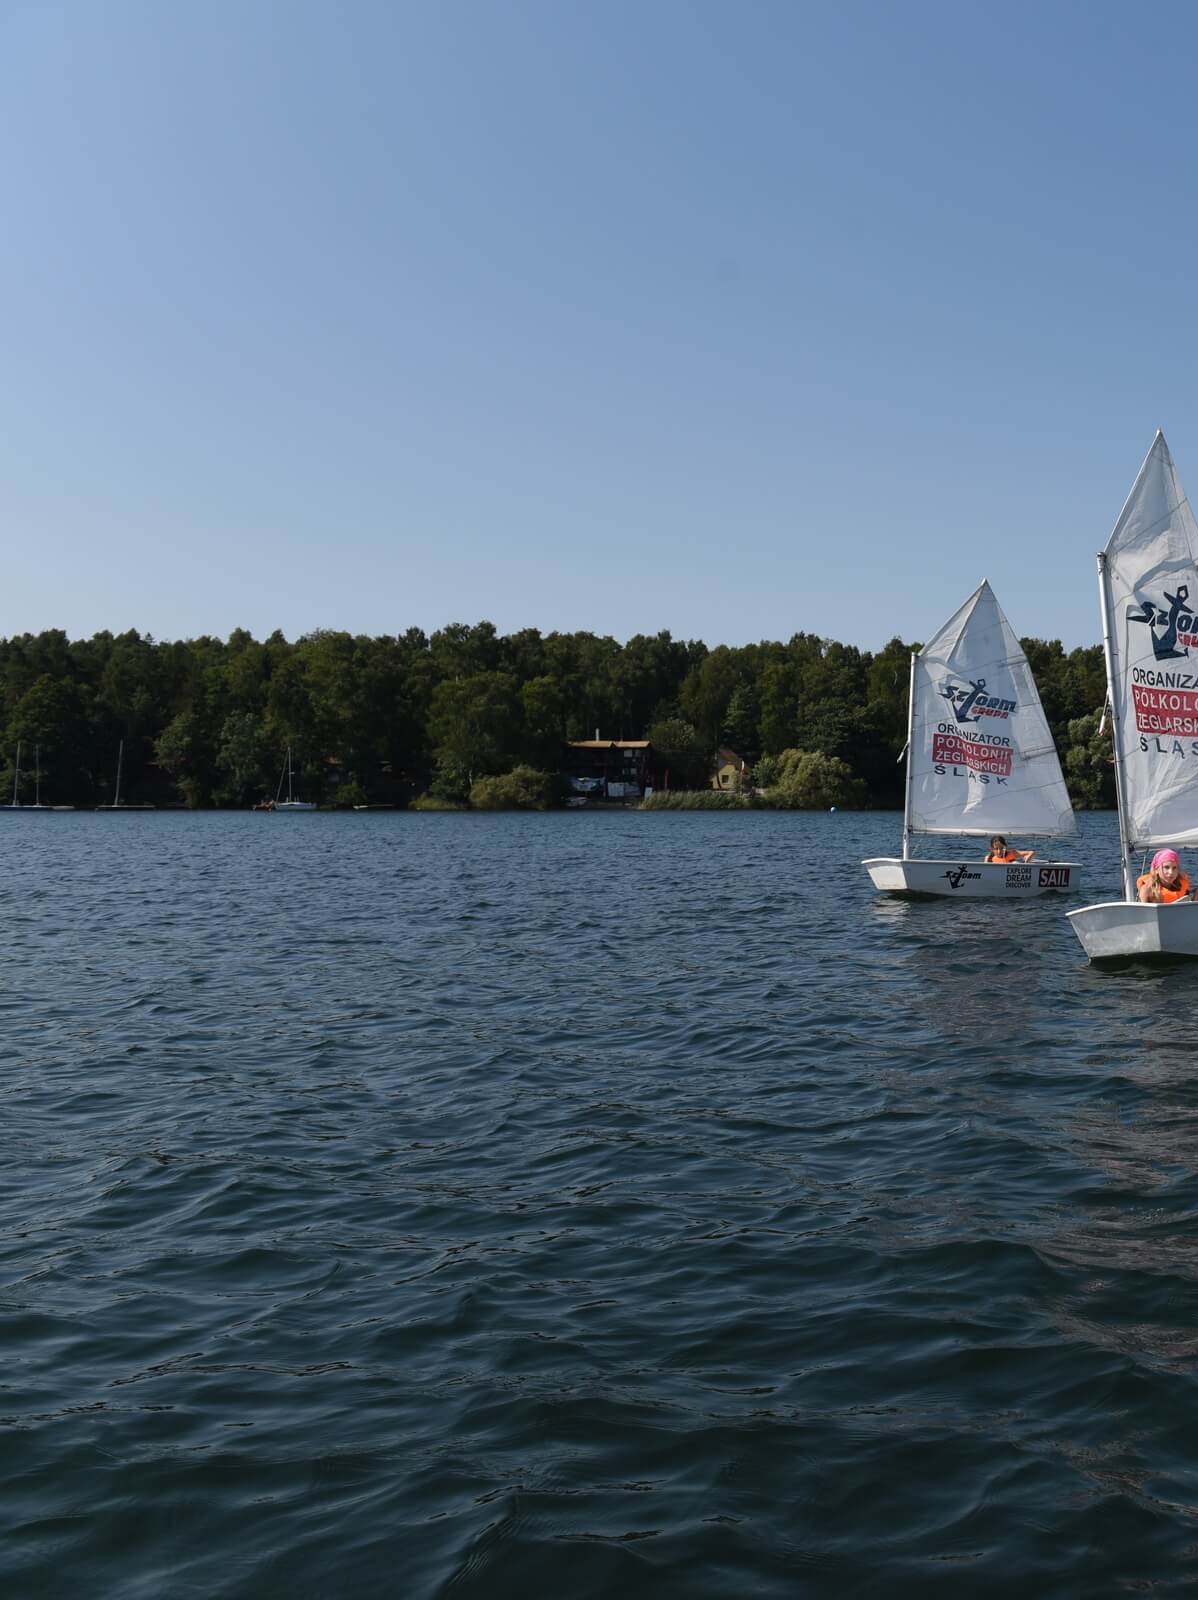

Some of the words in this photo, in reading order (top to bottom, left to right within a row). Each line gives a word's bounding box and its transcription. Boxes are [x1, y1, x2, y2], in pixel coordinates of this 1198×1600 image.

[971, 706, 1009, 719] GRUPA
[938, 723, 1010, 746] ORNIZATOR
[934, 764, 1008, 786] ŚLĄSK
[1040, 869, 1068, 886] SAIL
